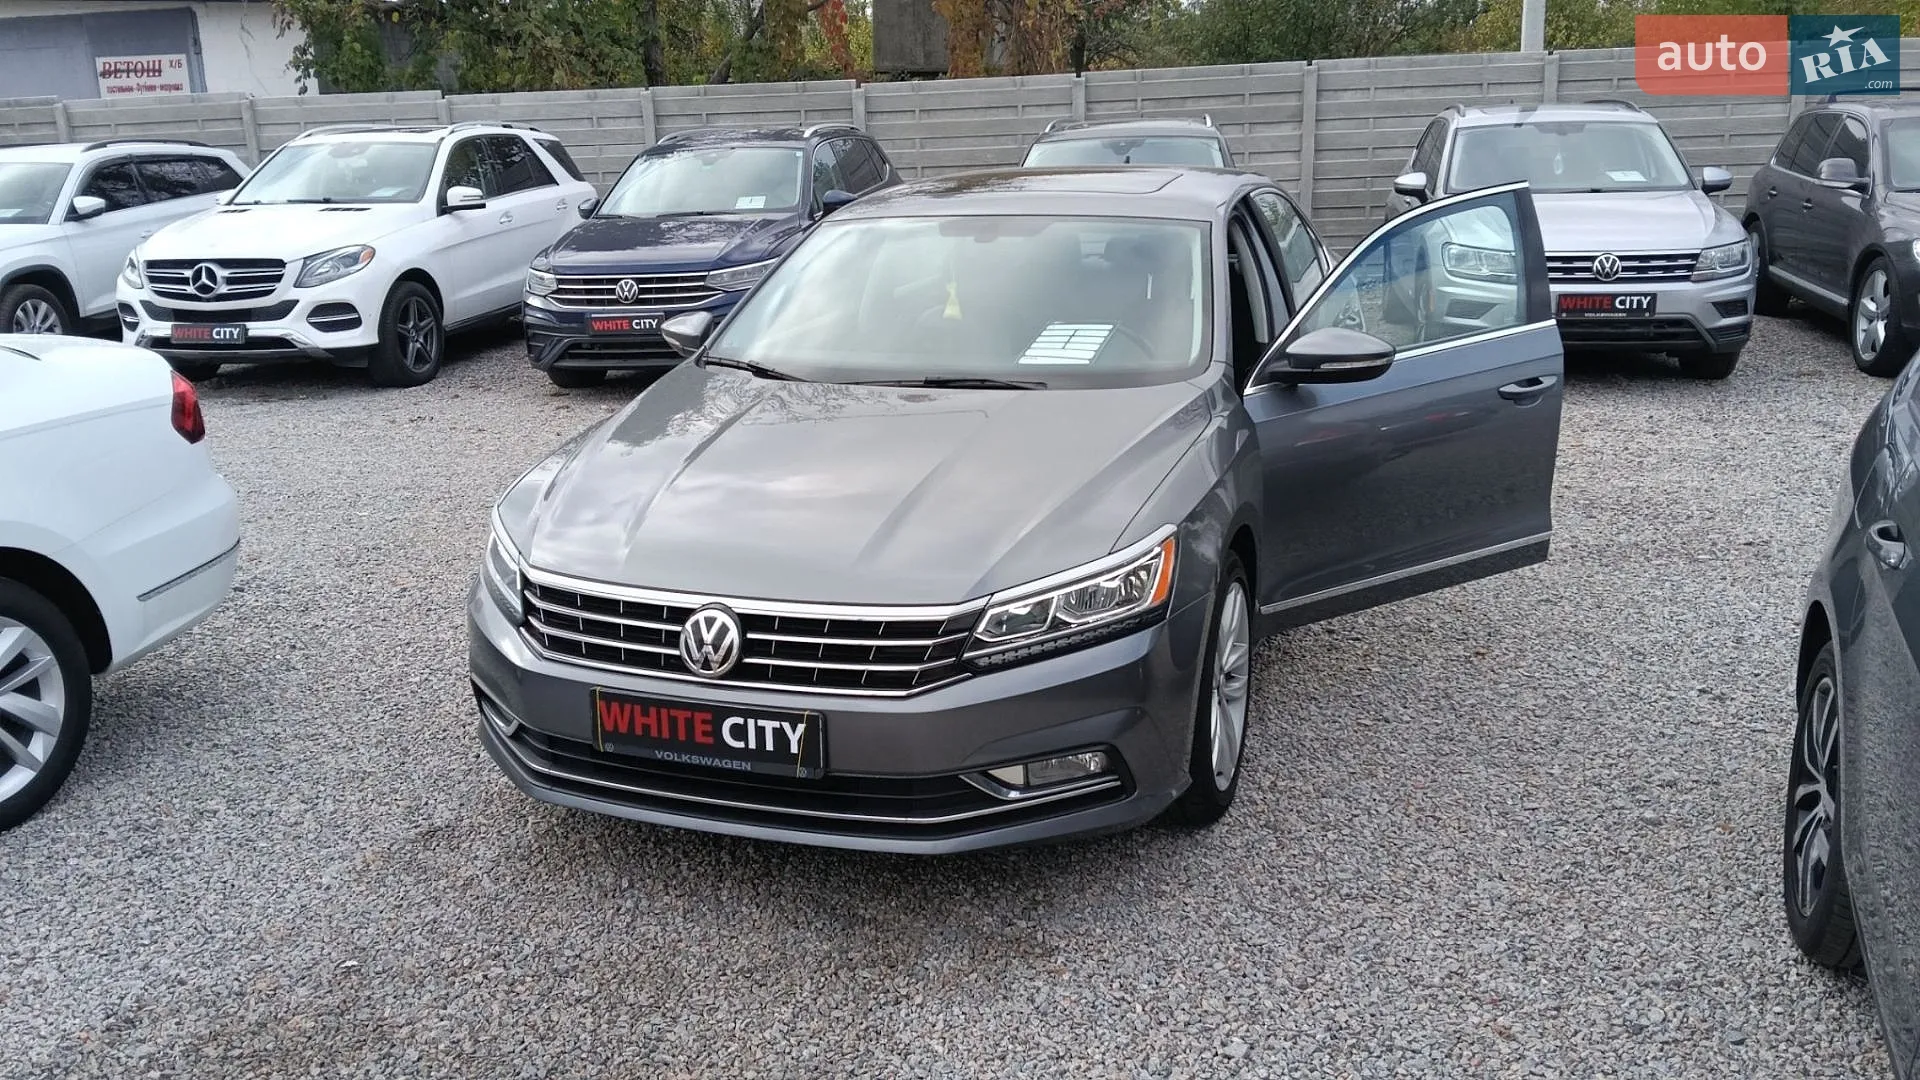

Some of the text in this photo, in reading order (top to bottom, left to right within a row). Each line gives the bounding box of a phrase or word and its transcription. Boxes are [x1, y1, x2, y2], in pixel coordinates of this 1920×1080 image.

[1561, 296, 1651, 310] WHITE CITY
[592, 319, 658, 331] WHITE CITY
[174, 327, 240, 339] WHITE CITY
[599, 700, 806, 755] WHITE CITY
[655, 750, 751, 771] VOLKSWAGEN
